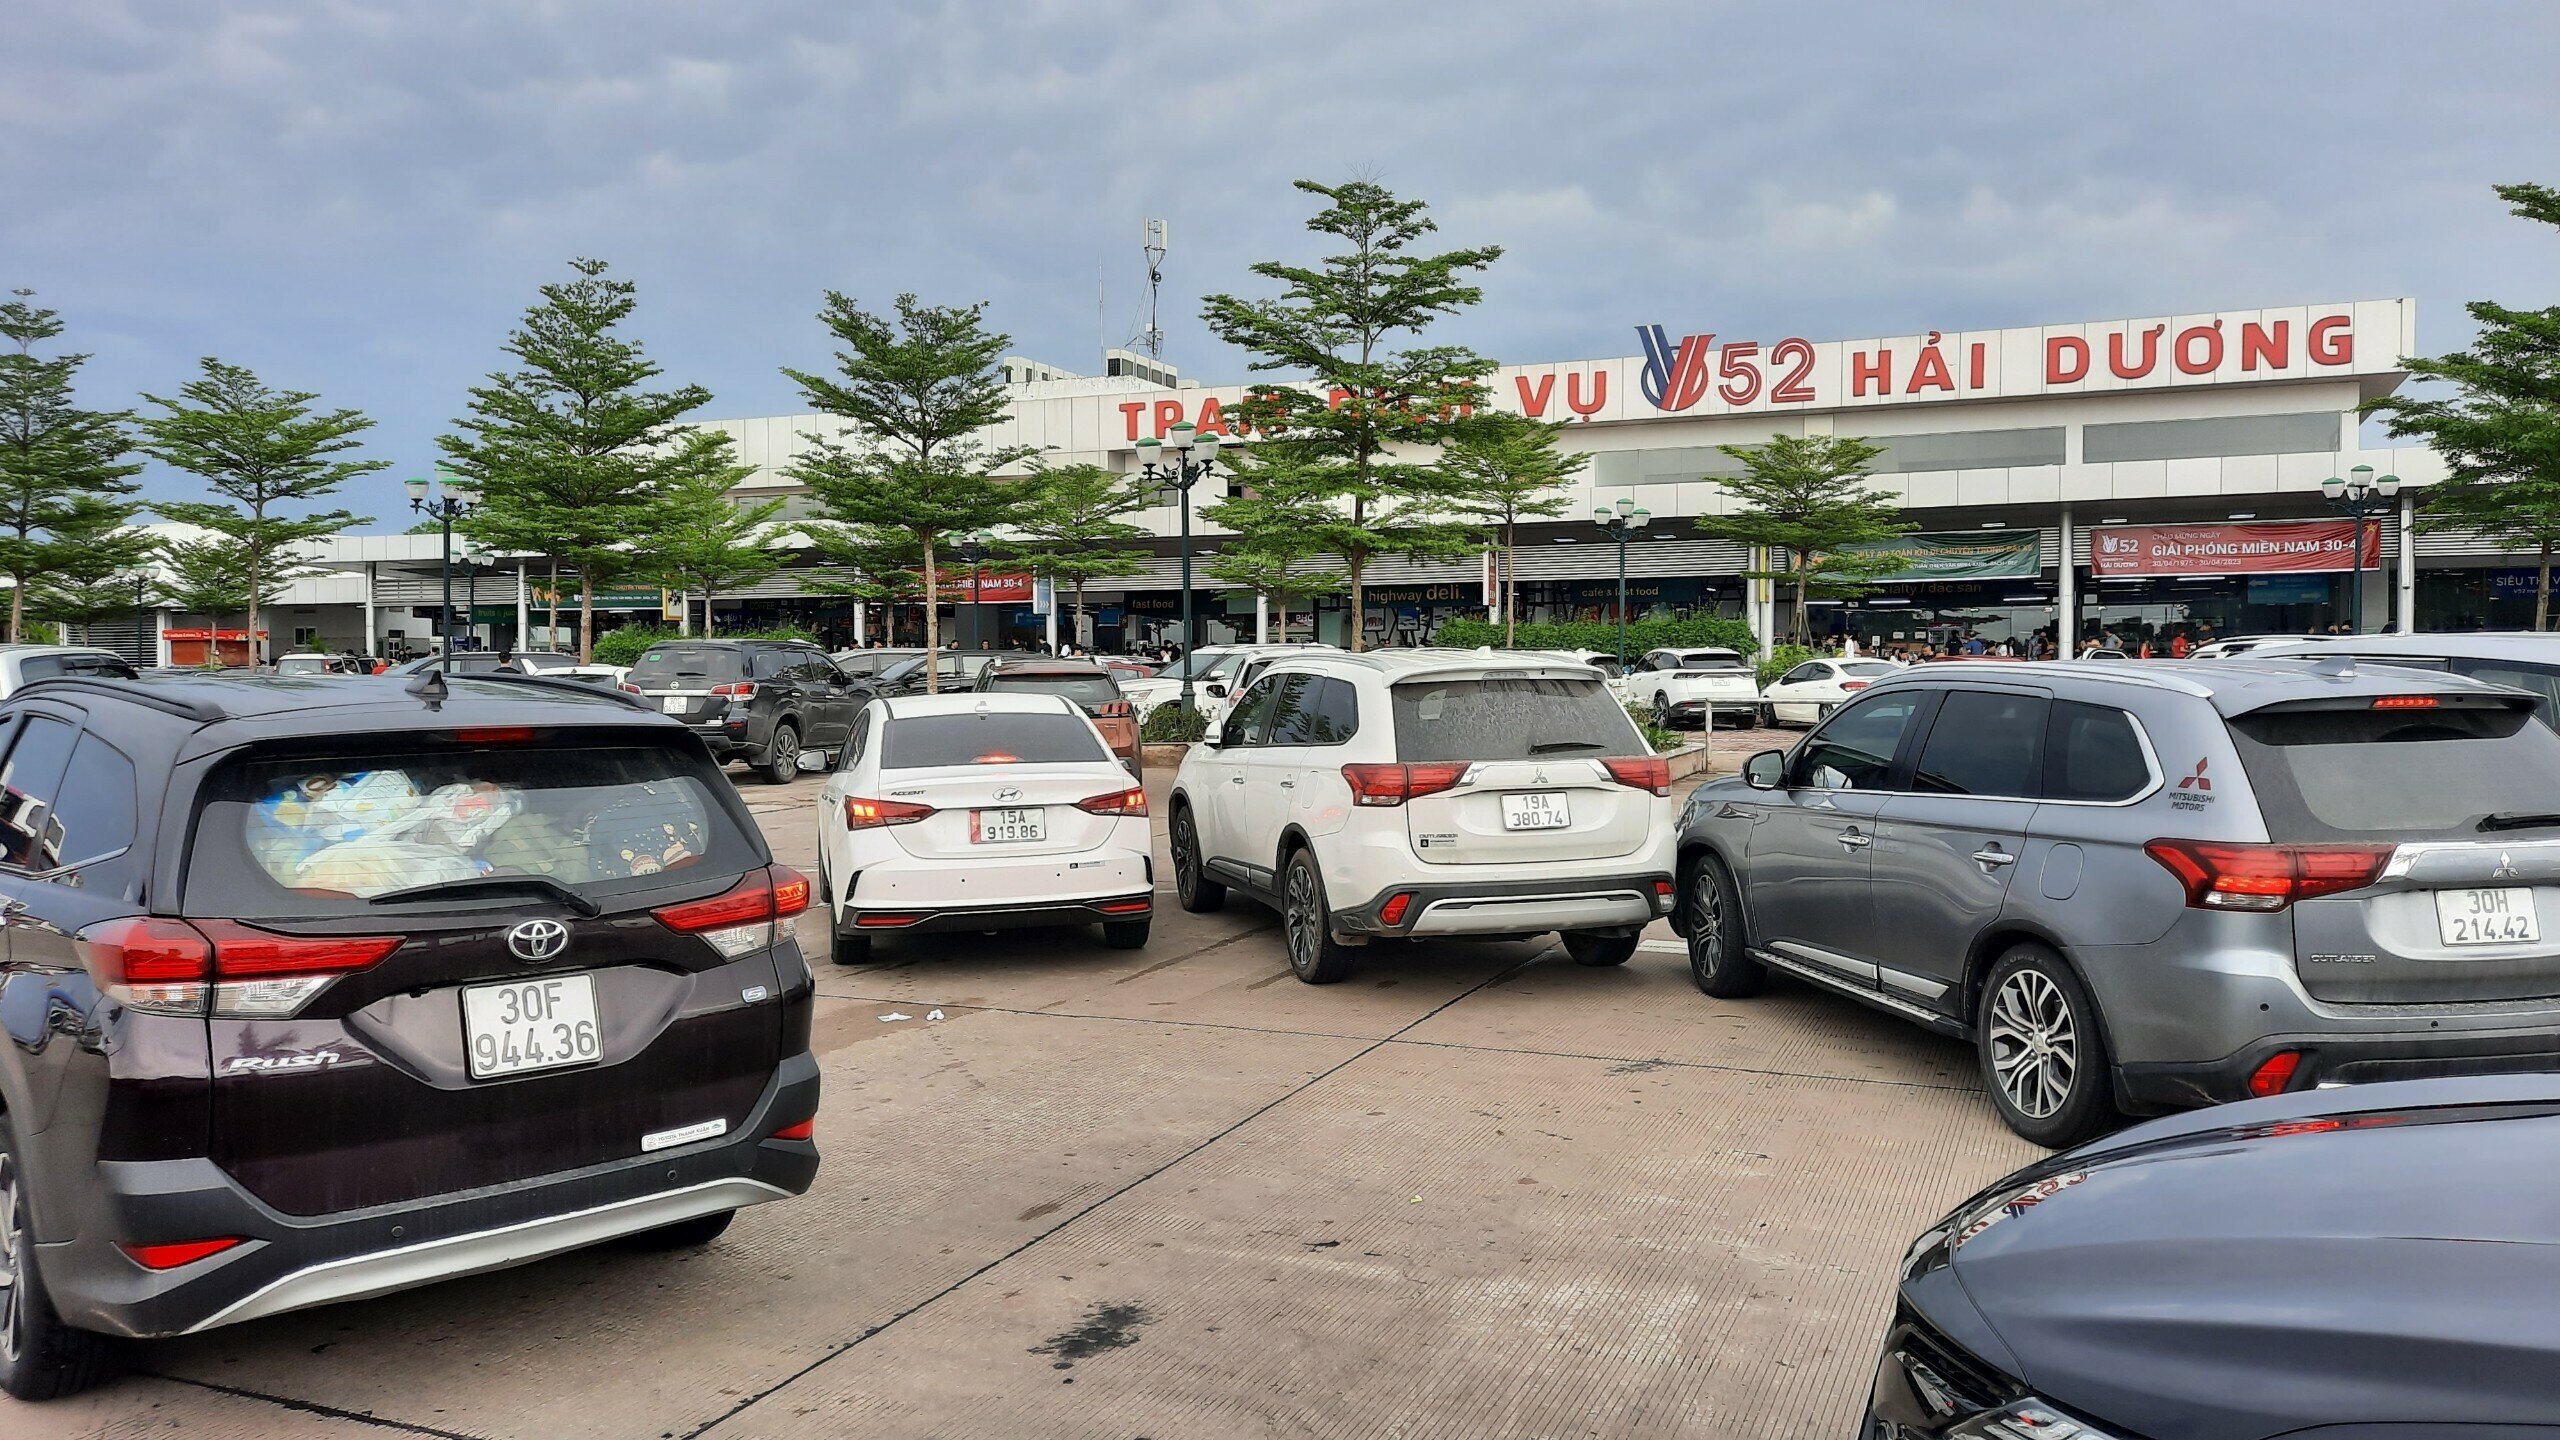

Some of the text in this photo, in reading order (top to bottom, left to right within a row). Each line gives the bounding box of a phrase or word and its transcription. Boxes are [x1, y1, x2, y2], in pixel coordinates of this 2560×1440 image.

[1515, 370, 1607, 423] VỤ
[1852, 330, 1985, 397] HẢI
[2046, 315, 2353, 386] DƯƠNG
[2186, 541, 2238, 555] PHÓNG
[2284, 541, 2320, 553] NAM
[981, 579, 1001, 588] NAM
[1004, 578, 1023, 588] 30-4
[2496, 575, 2524, 587] SIÊU
[1368, 589, 1423, 605] highway
[1636, 586, 1659, 596] food
[1132, 599, 1175, 609] fast food
[1522, 794, 1550, 810] 19A
[2168, 791, 2216, 804] MITSUBISHI
[2171, 801, 2205, 812] MOTORS
[1000, 810, 1026, 825] 15A
[1512, 810, 1564, 827] 380.74
[987, 825, 1039, 840] 919.86
[2467, 890, 2510, 915] 30H
[2453, 916, 2530, 942] 214.42
[2310, 953, 2377, 963] OUTLANDER
[498, 981, 564, 1025] 30F
[475, 1020, 598, 1072] 944.36
[229, 1049, 341, 1073] Rush
